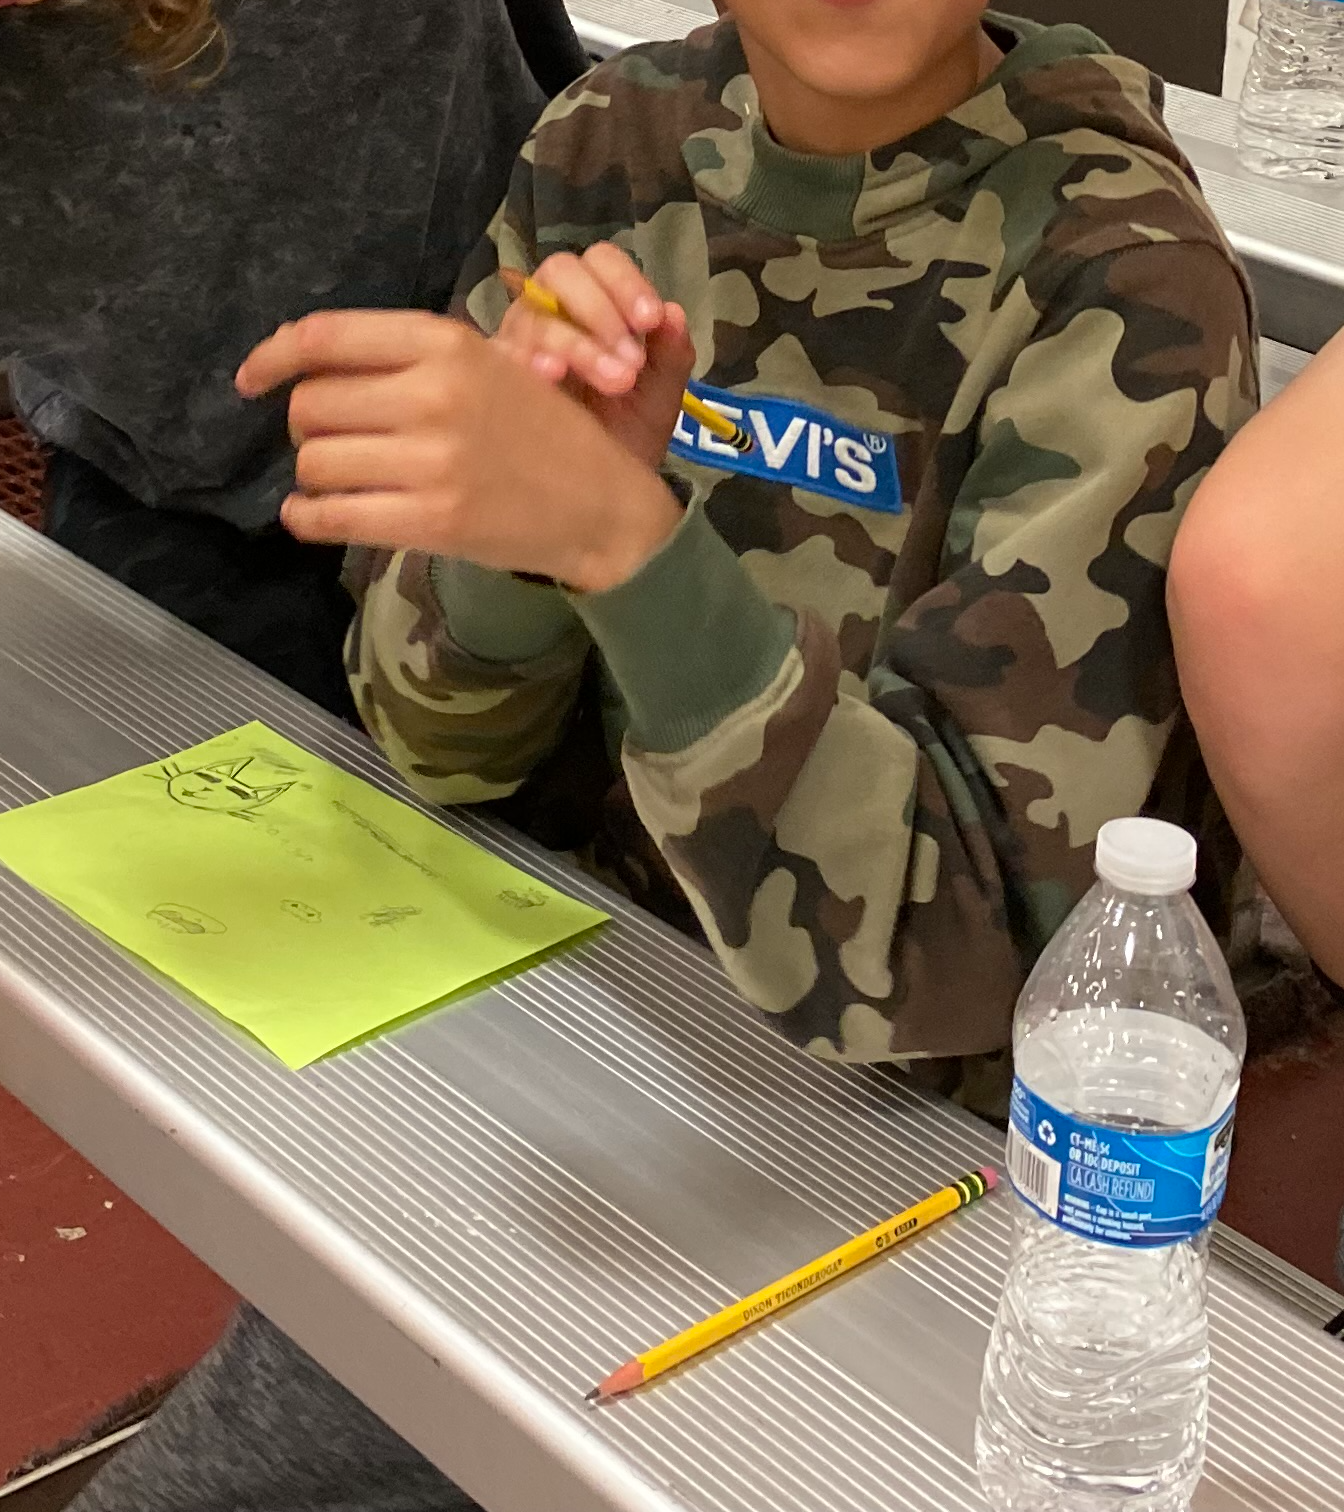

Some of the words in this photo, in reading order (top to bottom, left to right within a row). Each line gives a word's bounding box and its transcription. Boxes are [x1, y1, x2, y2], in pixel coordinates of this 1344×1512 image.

[1069, 1146, 1083, 1164] OR
[1100, 1156, 1141, 1177] DEPOSIT
[1070, 1167, 1083, 1186] CA
[1084, 1172, 1109, 1194] CASH
[1110, 1178, 1153, 1201] REFUND
[742, 1298, 774, 1322] DIXON
